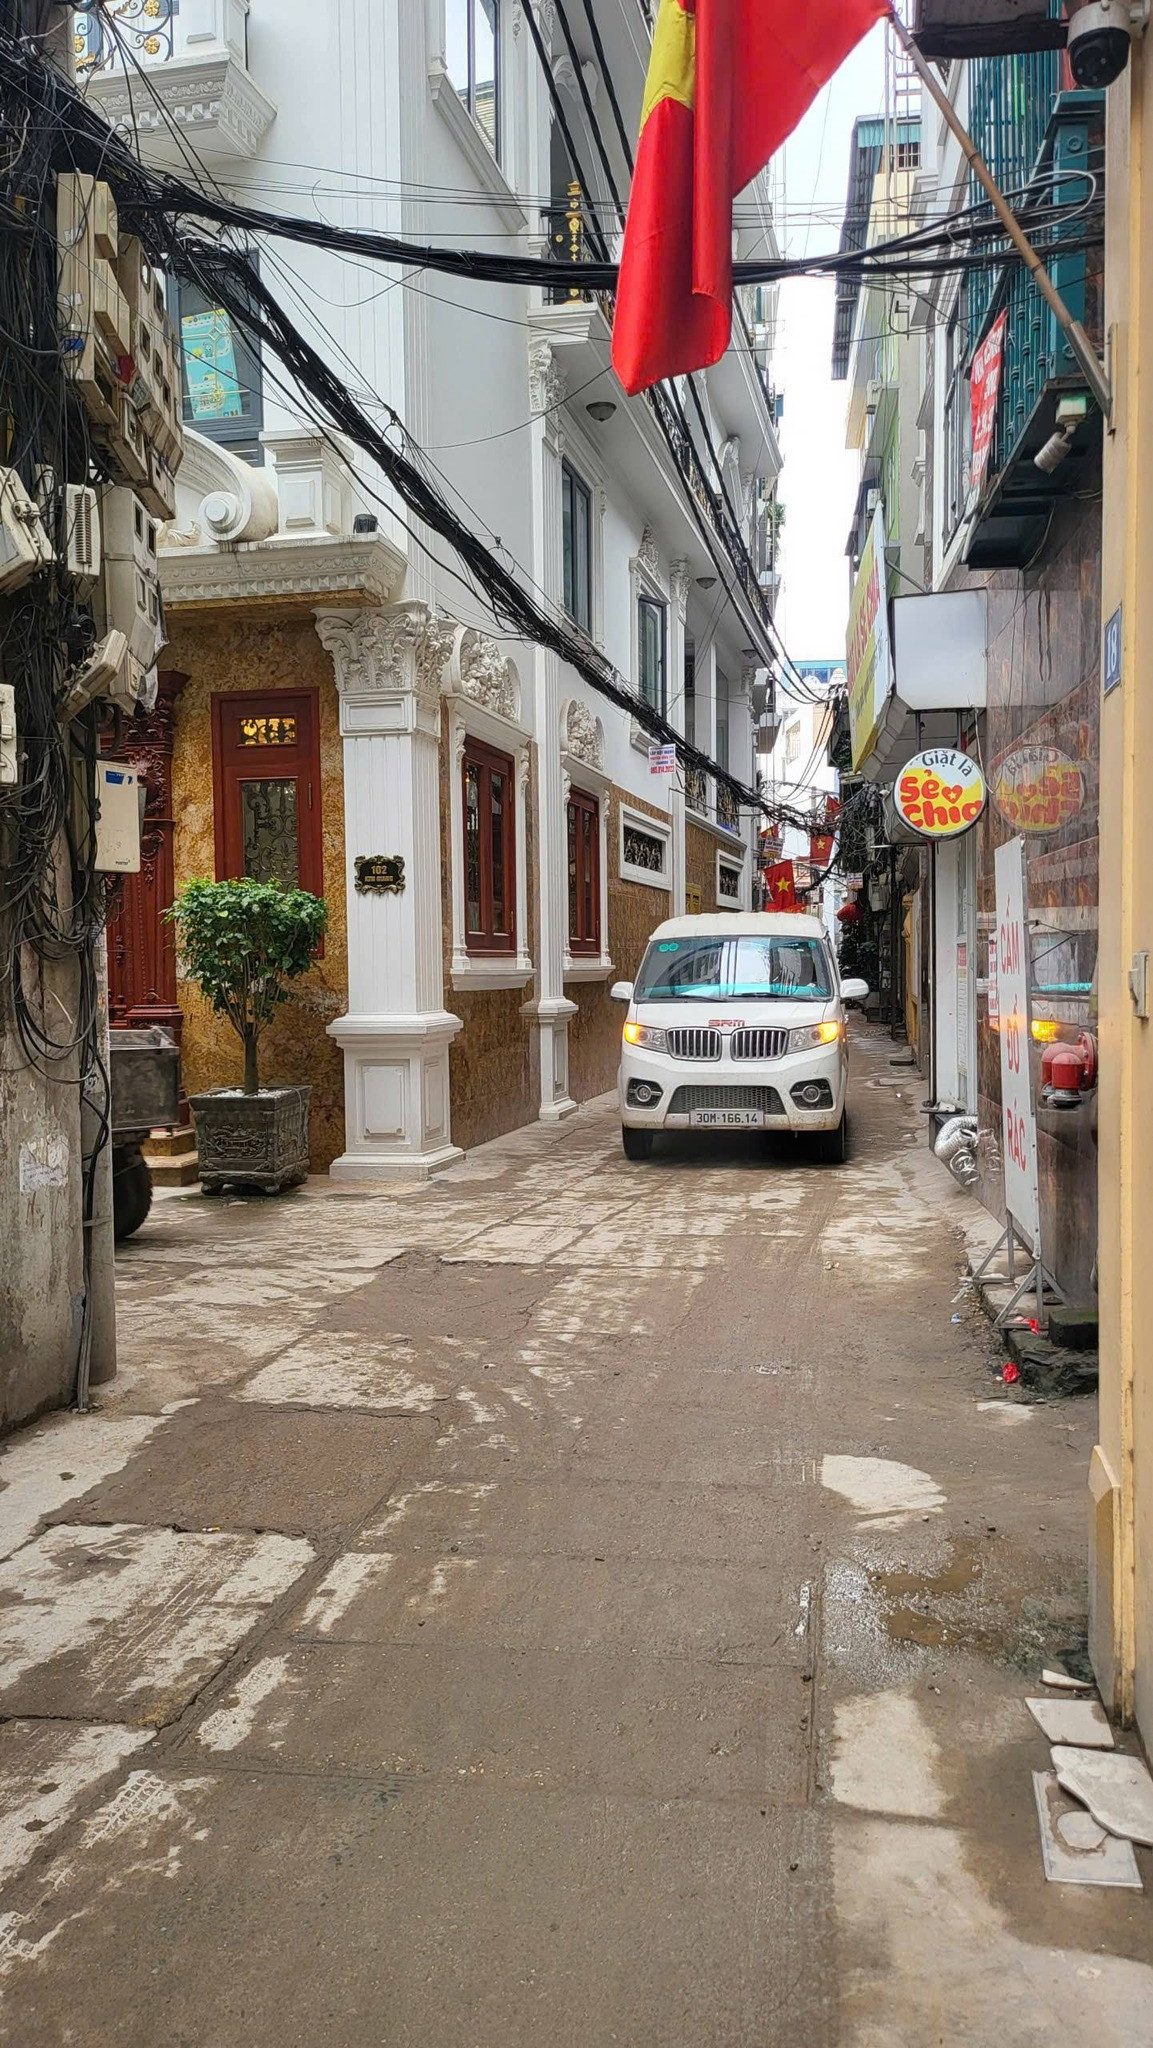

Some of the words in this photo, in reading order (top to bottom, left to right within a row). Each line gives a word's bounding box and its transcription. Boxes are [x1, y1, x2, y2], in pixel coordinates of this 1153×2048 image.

[1106, 622, 1118, 680] 18
[922, 750, 956, 767] Giặt
[371, 866, 387, 875] 102
[1001, 893, 1020, 975] CẤM
[708, 1019, 745, 1027] SRM
[696, 1113, 758, 1124] 30M-166.14
[1006, 1097, 1027, 1172] RÁC
